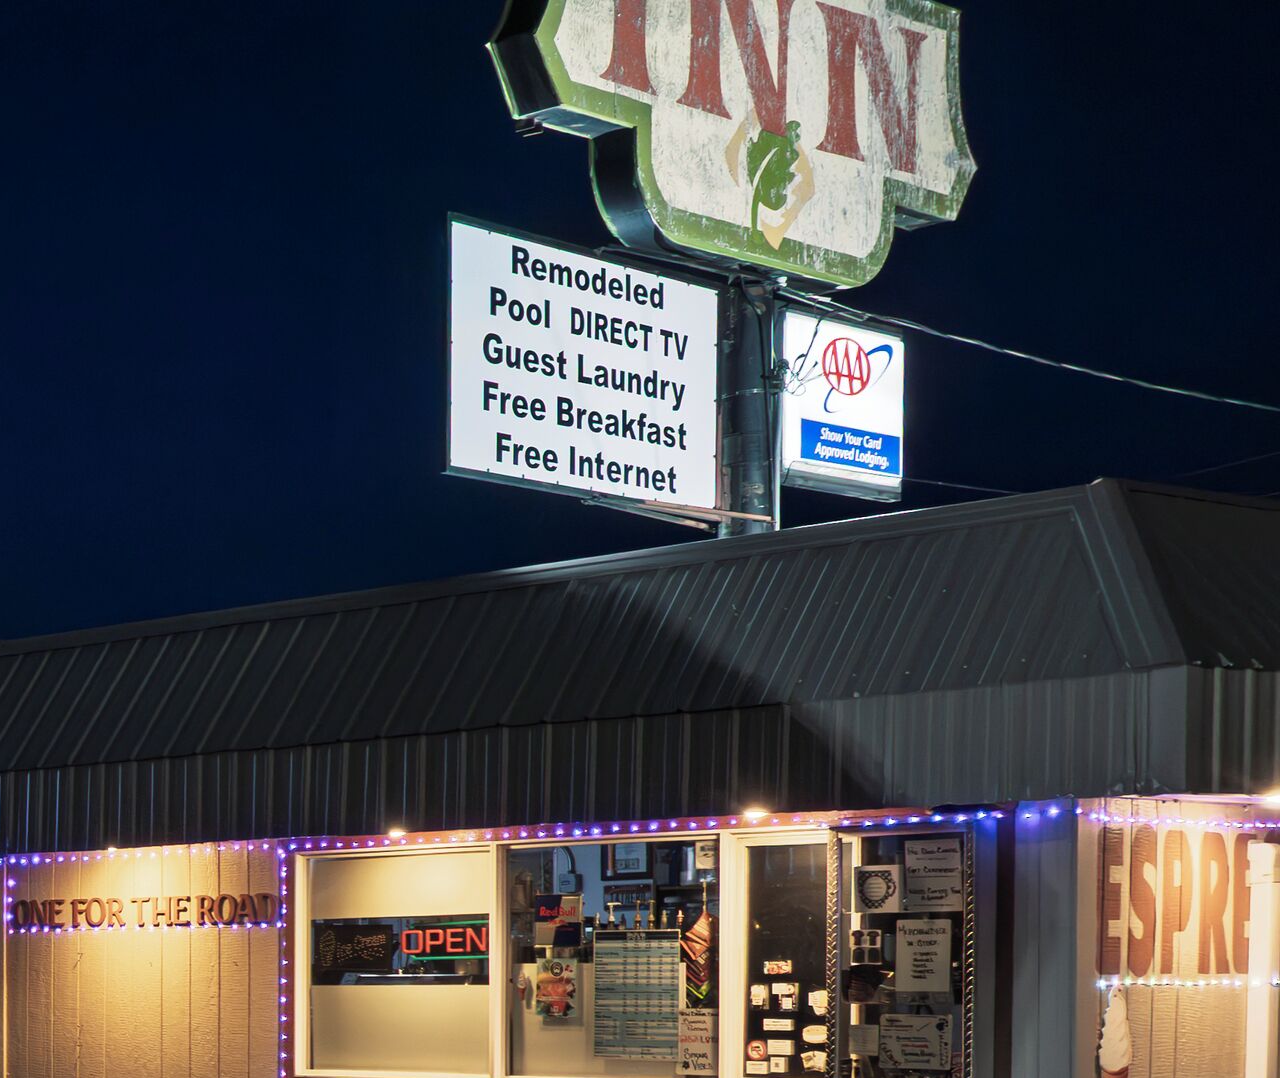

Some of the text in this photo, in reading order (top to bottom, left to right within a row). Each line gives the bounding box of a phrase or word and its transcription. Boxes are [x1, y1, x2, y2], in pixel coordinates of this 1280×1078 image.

[599, 0, 928, 175] INN
[511, 244, 665, 310] Remodeled
[489, 286, 689, 361] Pool DIRECT TV
[482, 332, 686, 412] Guest Laundry
[825, 339, 868, 395] AAA
[482, 380, 687, 451] Free Breakfast
[819, 427, 883, 451] Show Your Card
[496, 431, 677, 495] Free Internet
[814, 442, 855, 461] Approved
[13, 893, 281, 928] ONE FOR THE ROAD
[539, 905, 576, 917] Red Bull
[1096, 823, 1280, 977] ESPRE
[401, 927, 488, 954] OPEN
